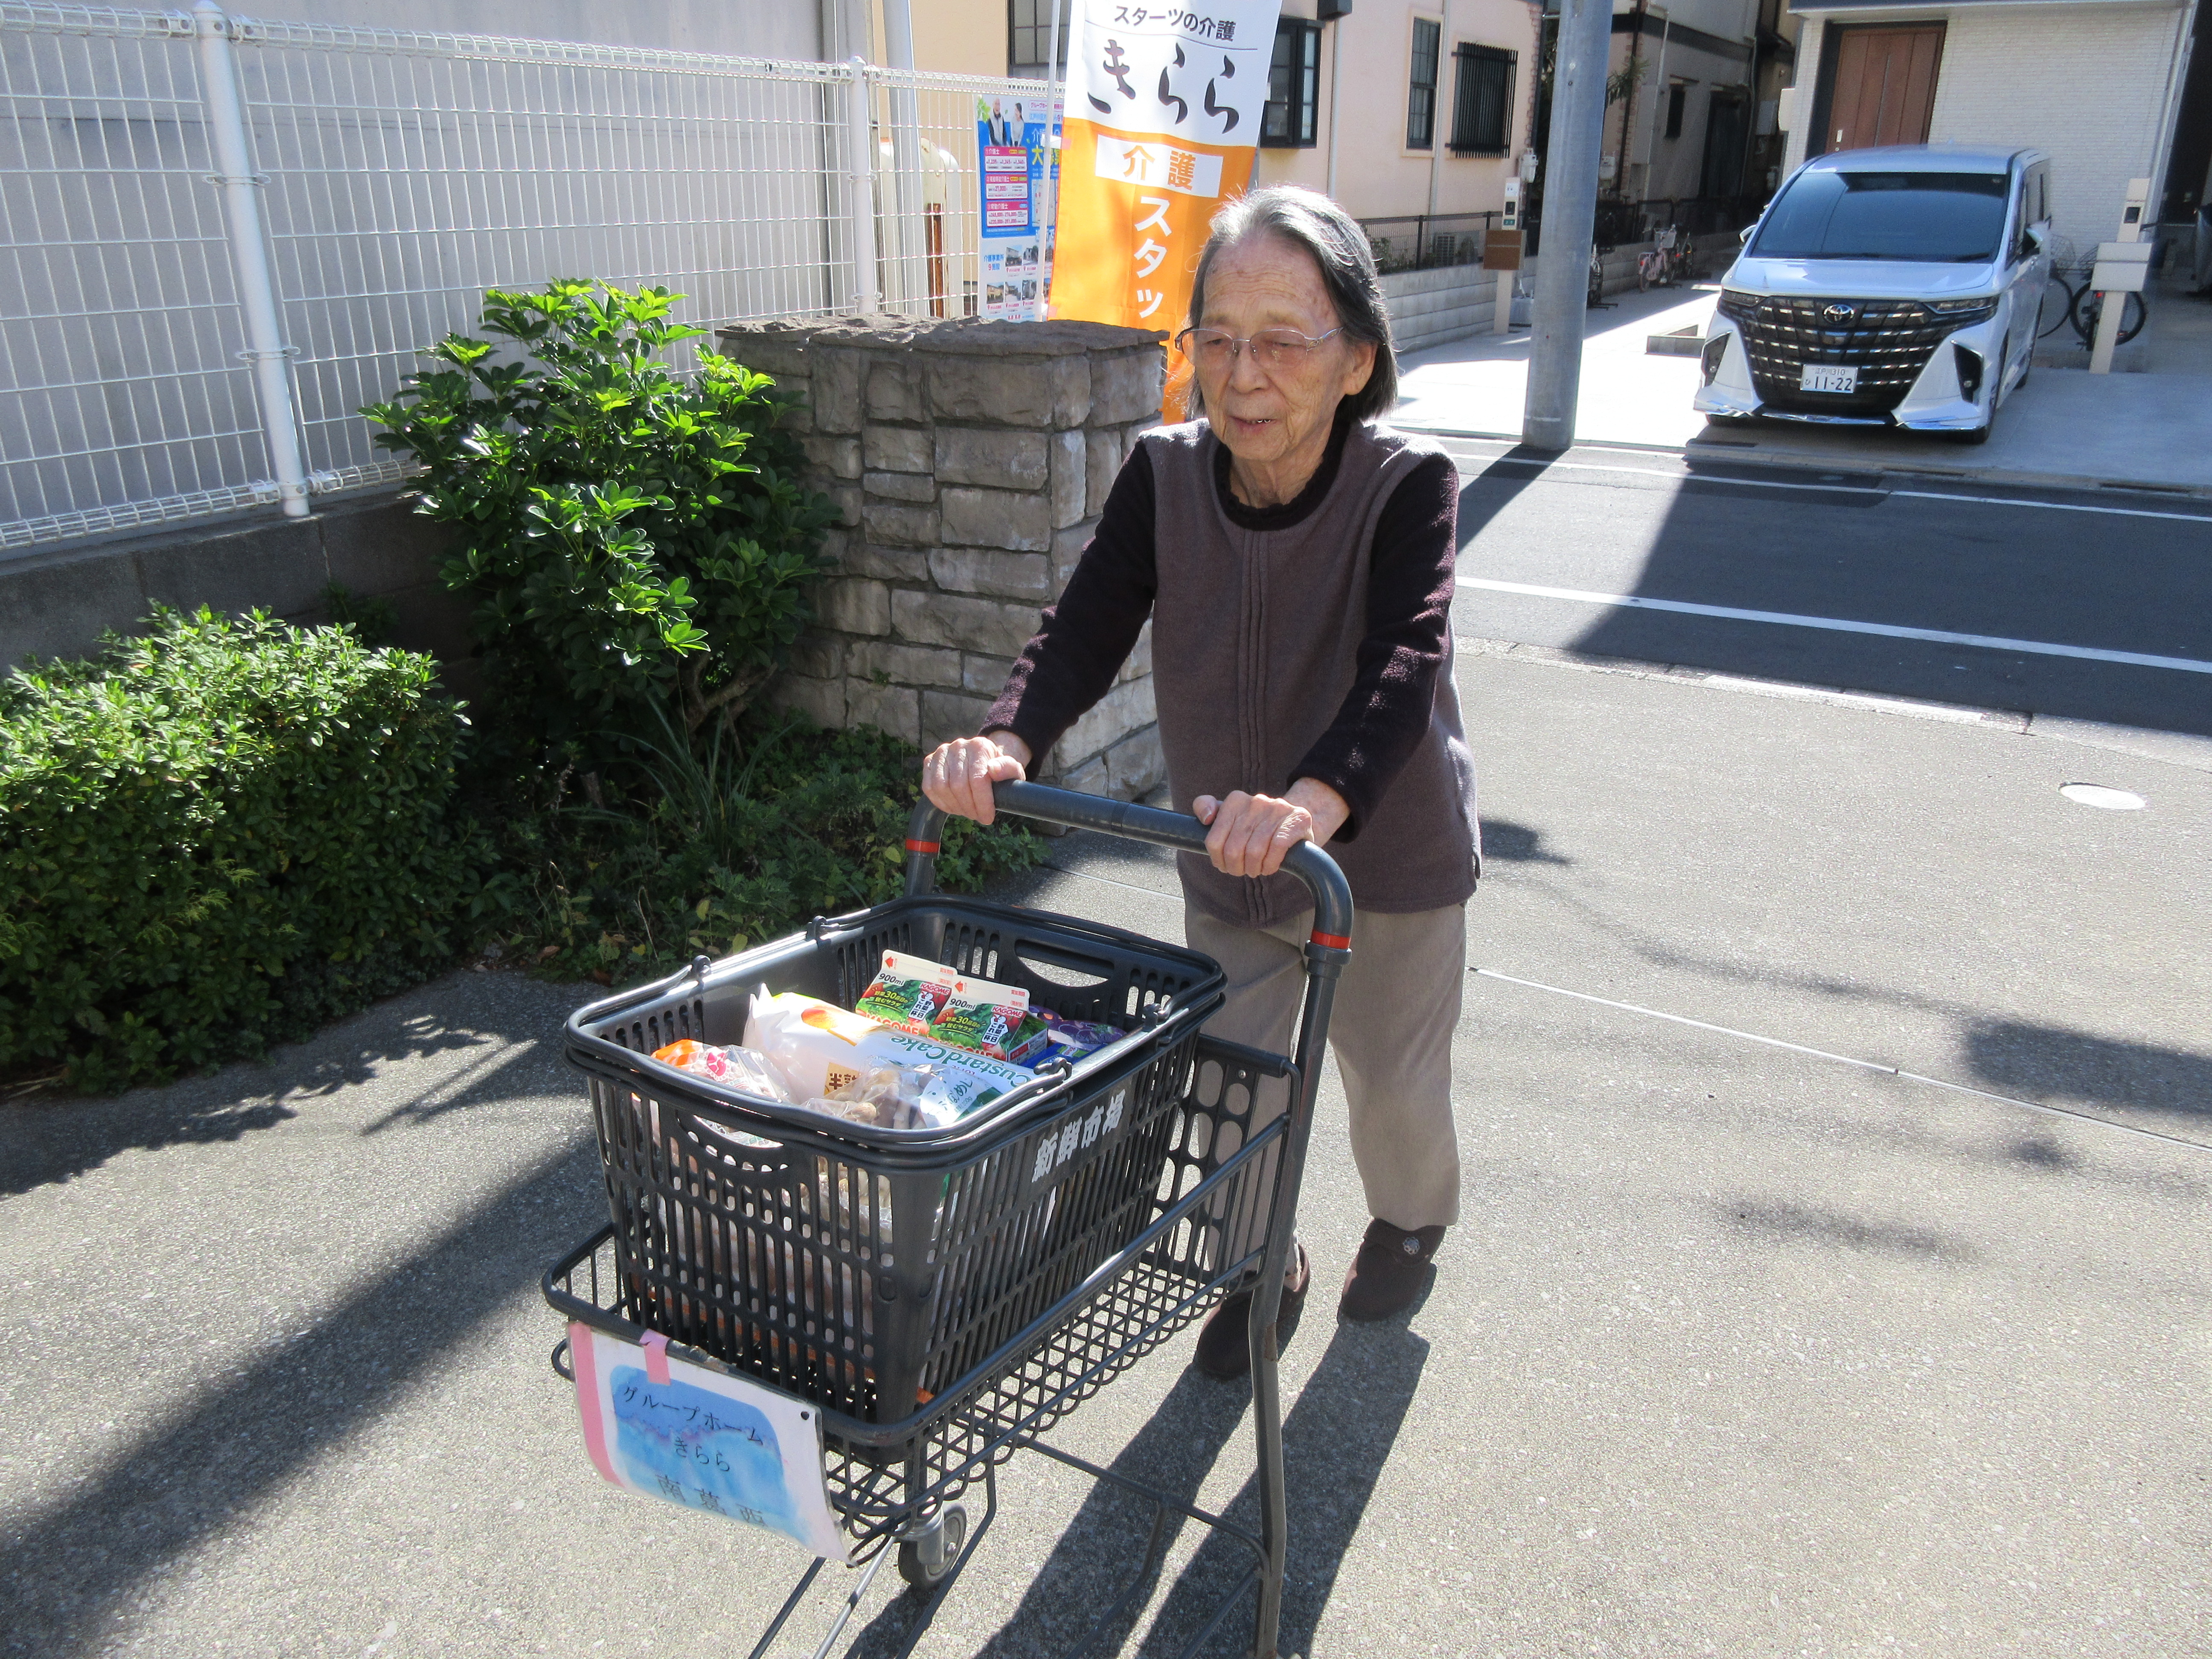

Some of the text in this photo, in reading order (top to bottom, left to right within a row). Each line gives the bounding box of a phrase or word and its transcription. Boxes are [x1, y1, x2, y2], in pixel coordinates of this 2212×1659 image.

[1114, 6, 1237, 41] スターツの介護
[1088, 39, 1239, 134] きらら
[1123, 146, 1196, 191] 介護
[1815, 376, 1852, 390] 11-22
[879, 973, 905, 986] 900ml
[920, 984, 949, 995] KAGOME
[875, 997, 901, 1007] 飲むサラダ
[949, 998, 975, 1010] 900ml
[993, 1007, 1022, 1017] KAGOME
[946, 1023, 974, 1032] 飲むサラダ
[1031, 1089, 1126, 1183] 新鮮市場
[623, 1386, 763, 1446] グループホーム
[675, 1438, 730, 1472] きらら
[656, 1474, 765, 1525] 南葛西
